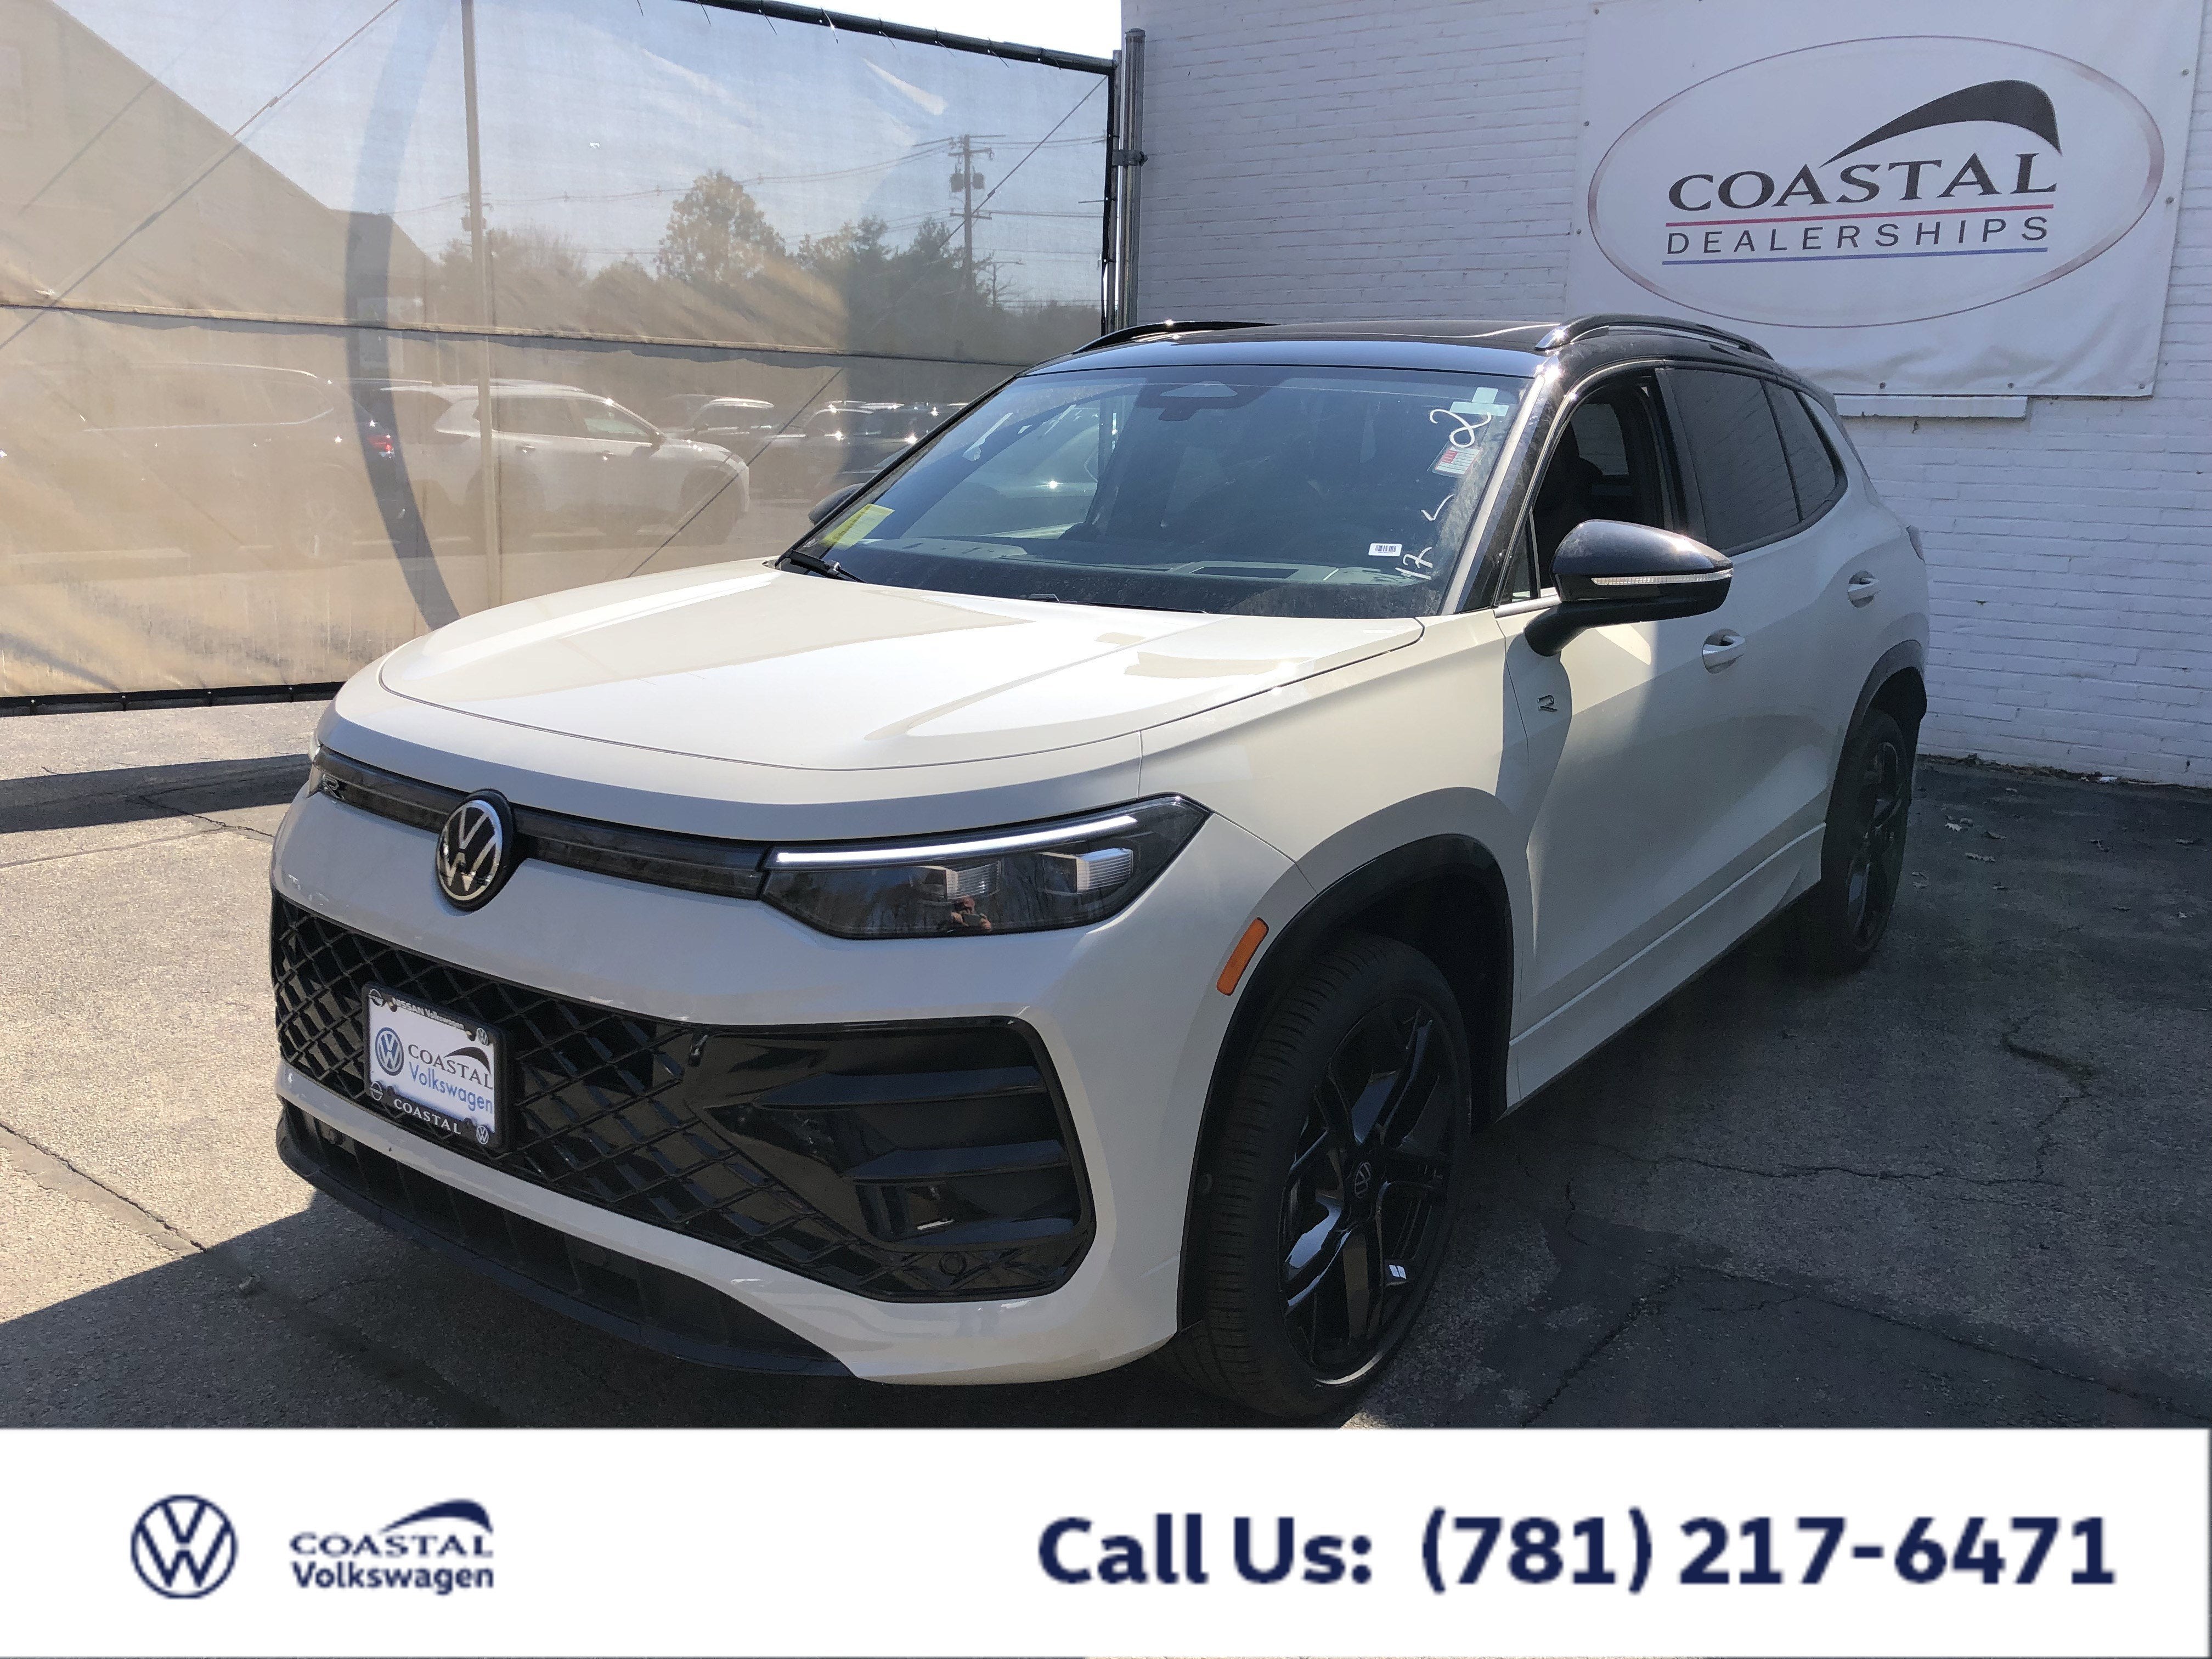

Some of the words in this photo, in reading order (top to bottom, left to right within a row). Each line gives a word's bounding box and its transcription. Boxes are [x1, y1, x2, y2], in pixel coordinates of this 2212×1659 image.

[1668, 152, 2057, 211] COASTAL
[1667, 216, 2047, 255] DEALERSHIPS
[408, 1044, 493, 1090] COASTAL
[409, 1061, 493, 1114] Volkswagen
[394, 1099, 461, 1135] COASTAL
